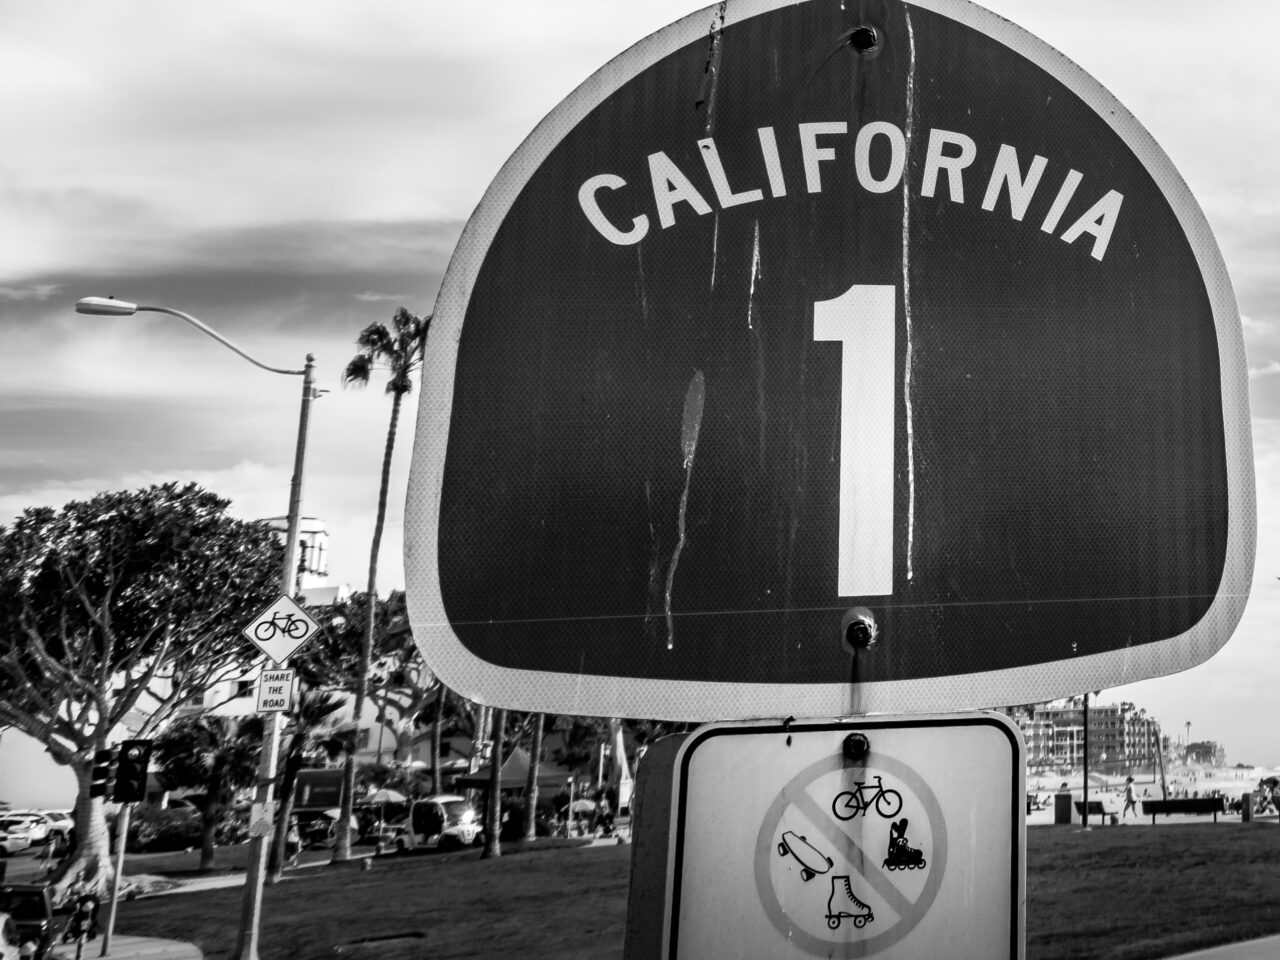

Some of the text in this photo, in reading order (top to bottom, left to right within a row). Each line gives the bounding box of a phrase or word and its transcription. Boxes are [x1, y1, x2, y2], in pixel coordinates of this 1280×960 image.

[578, 121, 1125, 262] CALIFORNIA
[813, 284, 896, 597] 1
[263, 673, 291, 682] SHARE
[268, 685, 283, 695] THE
[262, 699, 285, 708] ROAD
